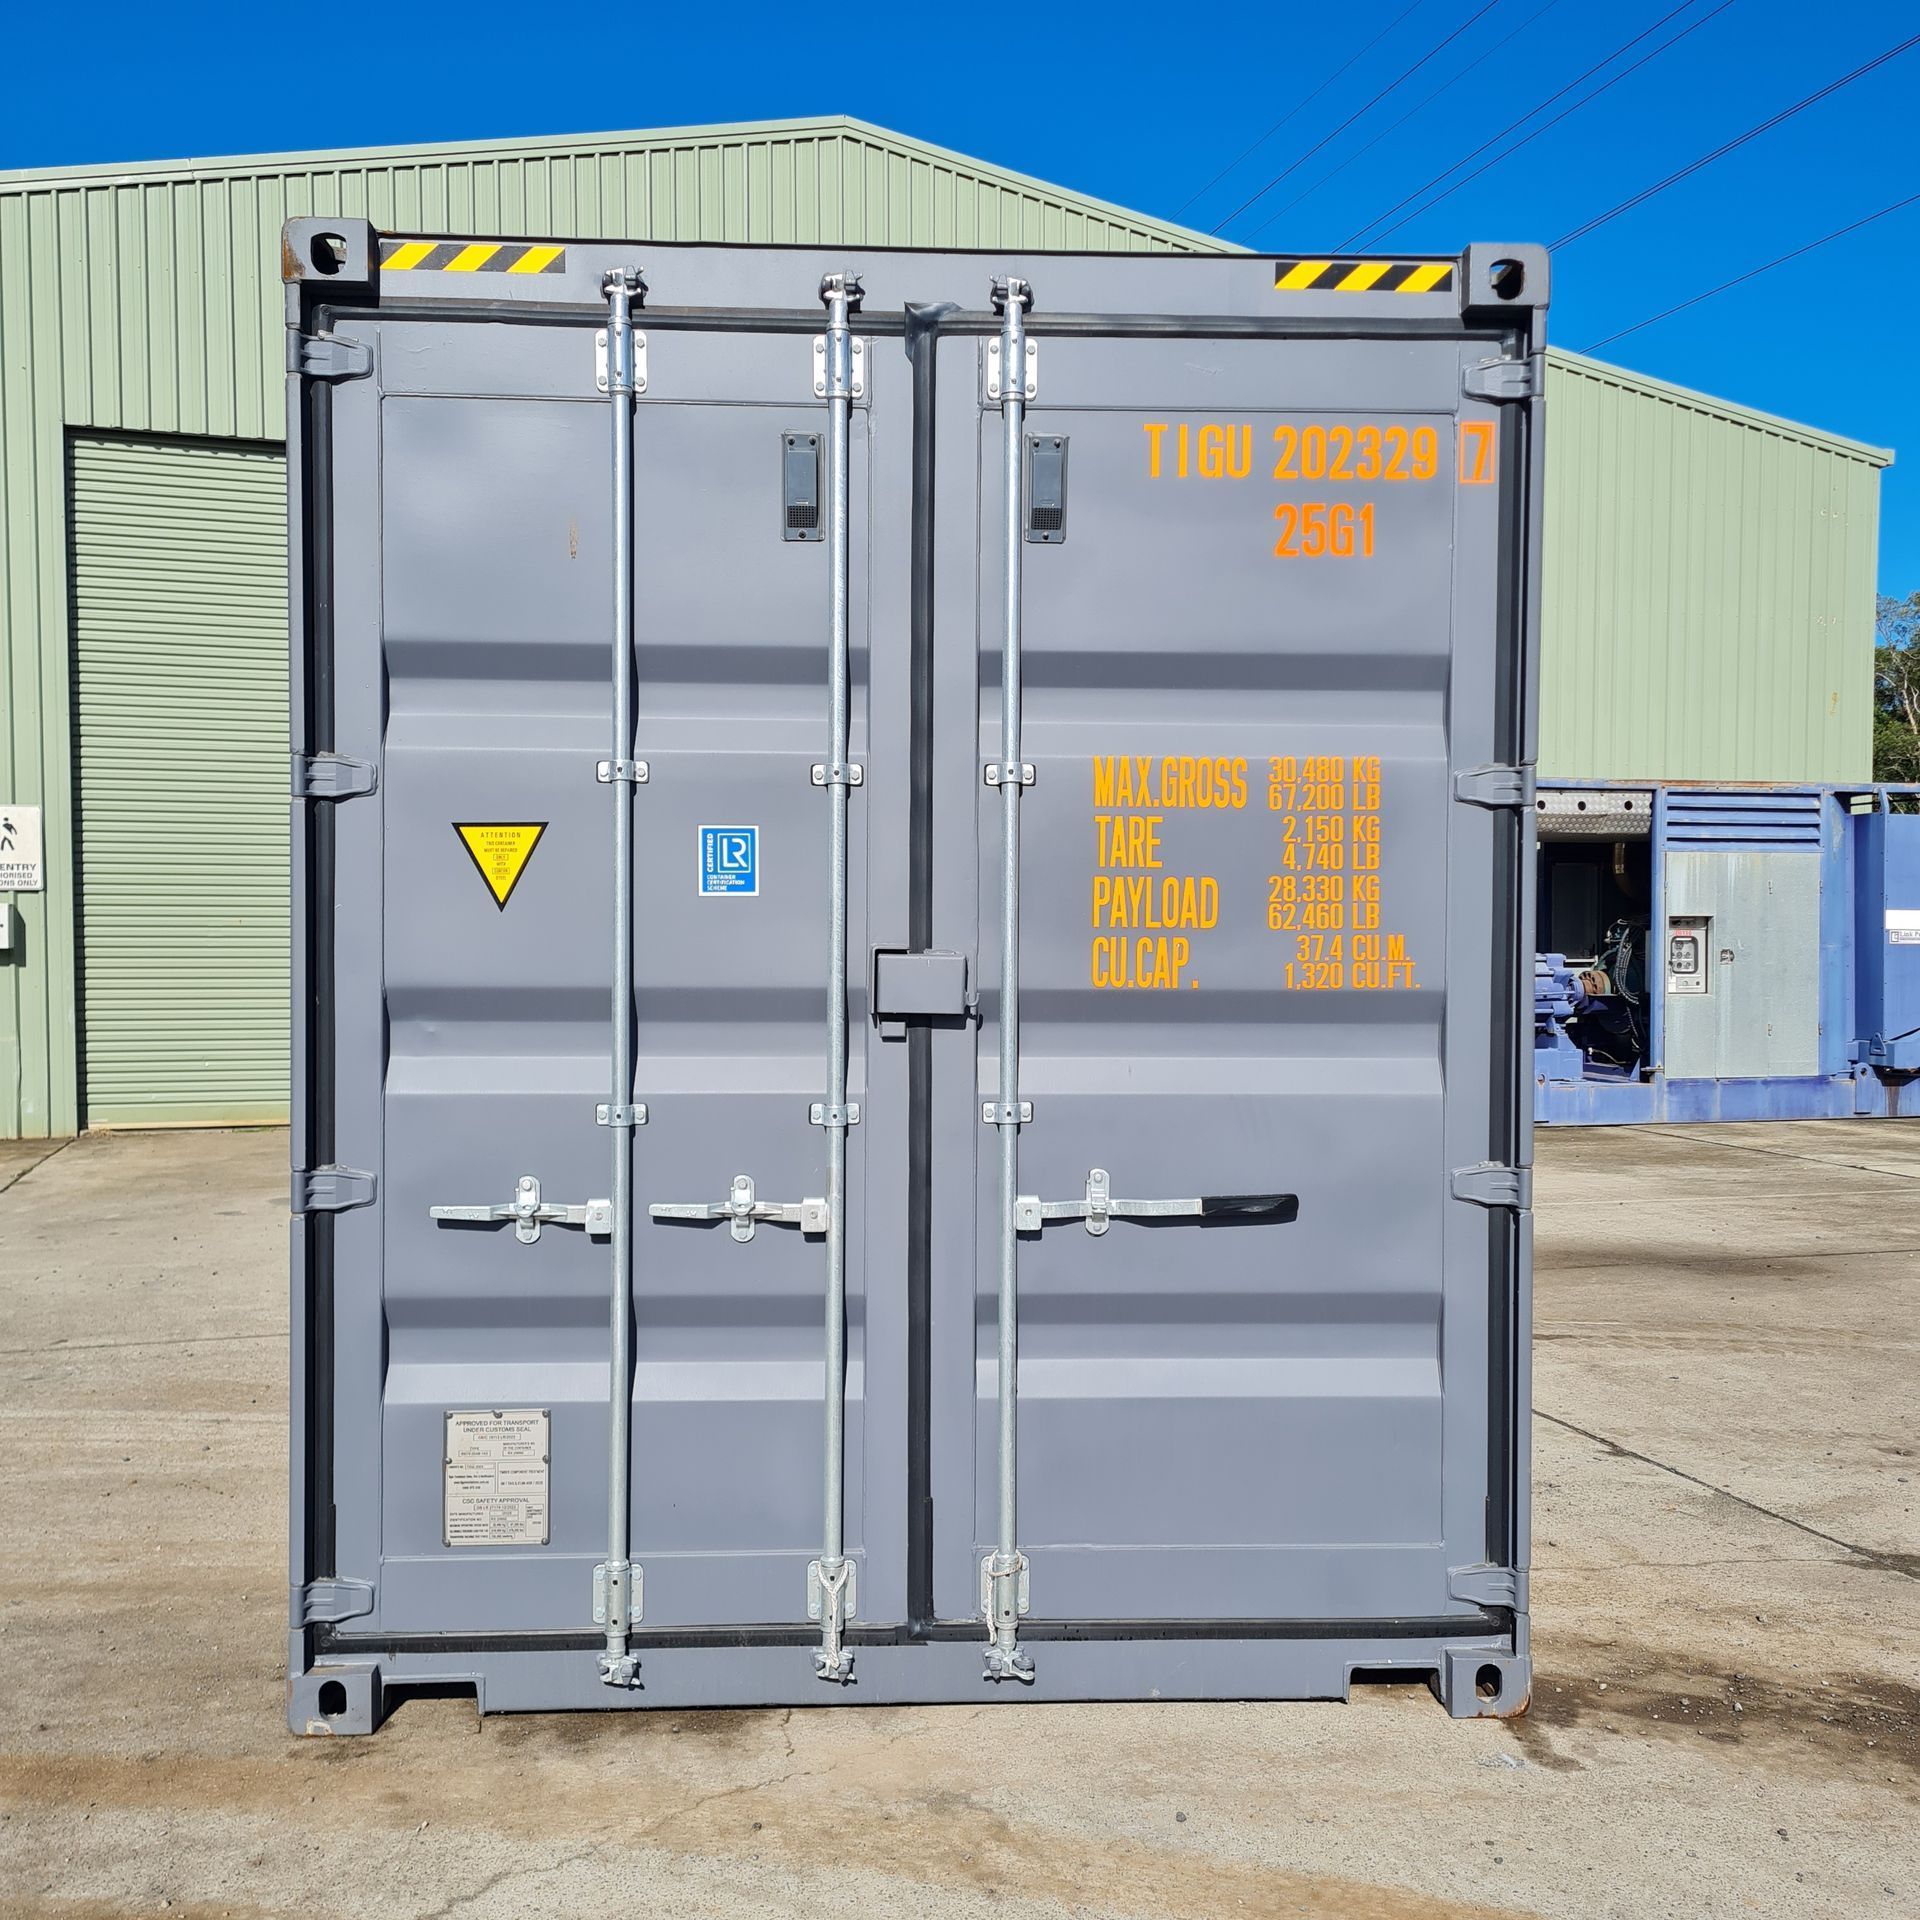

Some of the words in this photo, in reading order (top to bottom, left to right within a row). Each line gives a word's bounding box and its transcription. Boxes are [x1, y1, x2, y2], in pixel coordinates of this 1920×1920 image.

[1144, 424, 1251, 478] TIGU
[1273, 425, 1438, 480] 202329
[1466, 425, 1489, 481] 7
[1273, 503, 1374, 557] 25G1
[1092, 755, 1247, 809] MAX.GROSS
[1268, 756, 1344, 784] 30,480
[1352, 756, 1381, 783] KG
[1268, 783, 1344, 811] 67,200
[1352, 784, 1381, 811] LB
[1094, 815, 1163, 868] TARE
[1282, 815, 1344, 843] 2,150
[1352, 815, 1381, 842] KG
[706, 833, 714, 872] CERTIFIED
[722, 838, 748, 868] LR
[1282, 843, 1344, 871] 4,740
[1352, 843, 1381, 870] LB
[1092, 875, 1219, 929] PAYLOAD
[1268, 875, 1344, 902] 28,330
[1352, 875, 1381, 901] KG
[1268, 902, 1344, 930] 62,460
[1352, 903, 1381, 930] LB
[1296, 934, 1343, 962] 37.4
[1351, 934, 1411, 962] CU.M.
[1285, 962, 1343, 990] 1,320
[1352, 962, 1421, 989] CU.FT.
